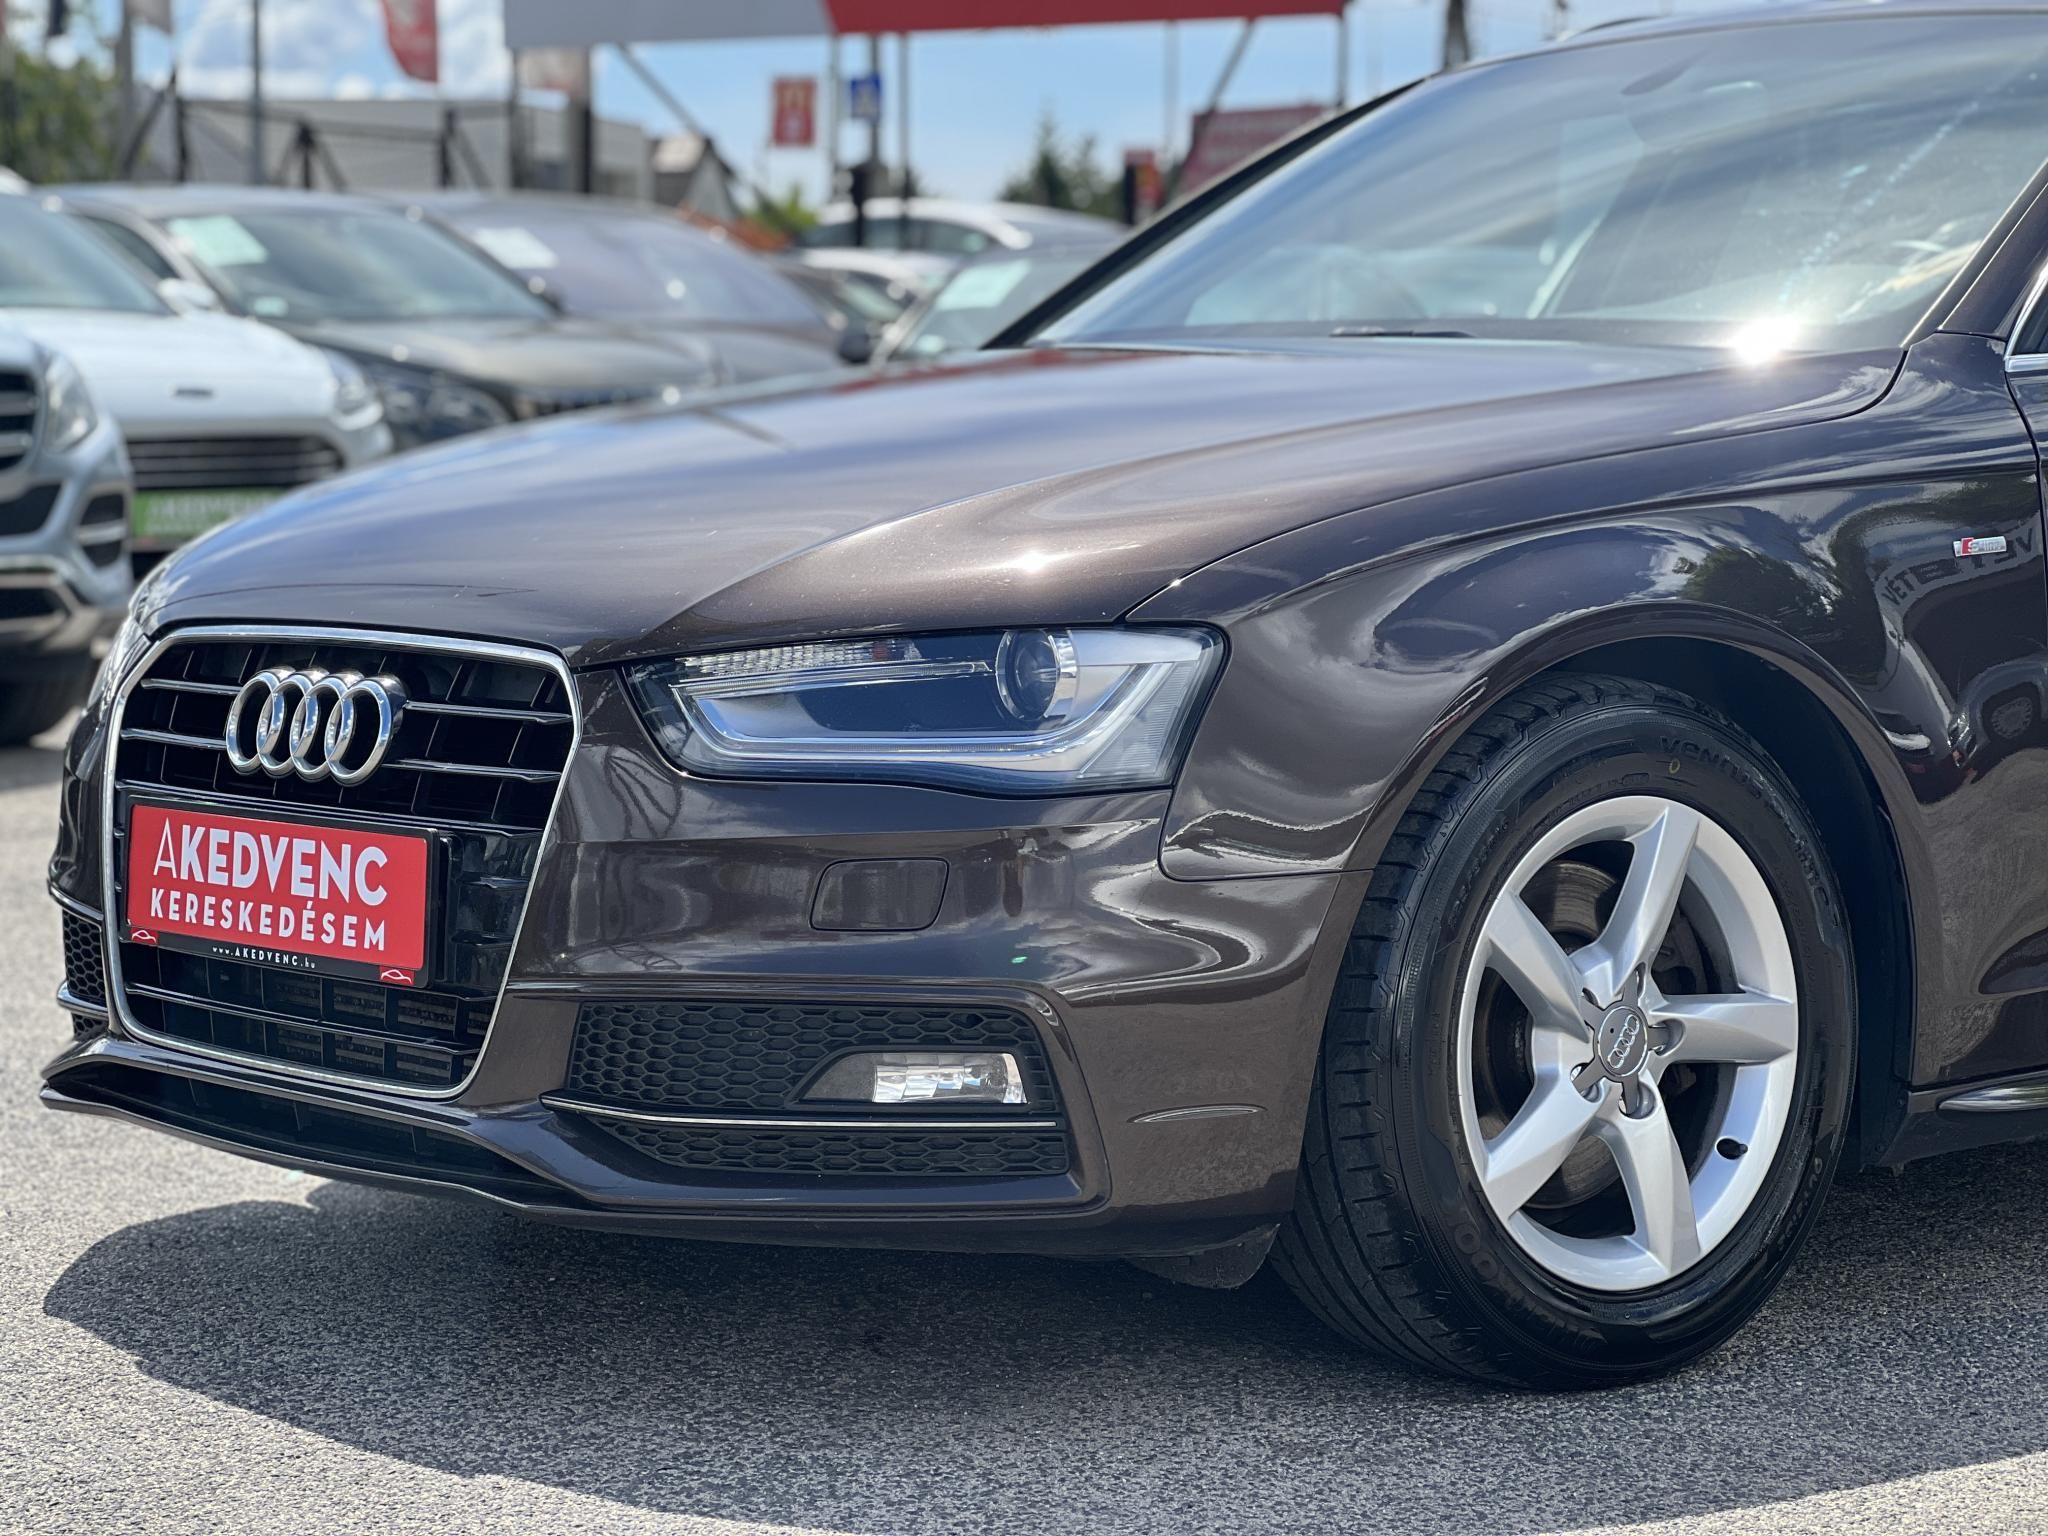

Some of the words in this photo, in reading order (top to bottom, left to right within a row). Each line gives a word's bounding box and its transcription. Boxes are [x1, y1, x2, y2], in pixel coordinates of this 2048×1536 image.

[153, 817, 388, 906] AKEDVENC
[151, 887, 385, 951] KERESKEDÉSEM
[212, 946, 316, 969] www.AKEDVENC.hu
